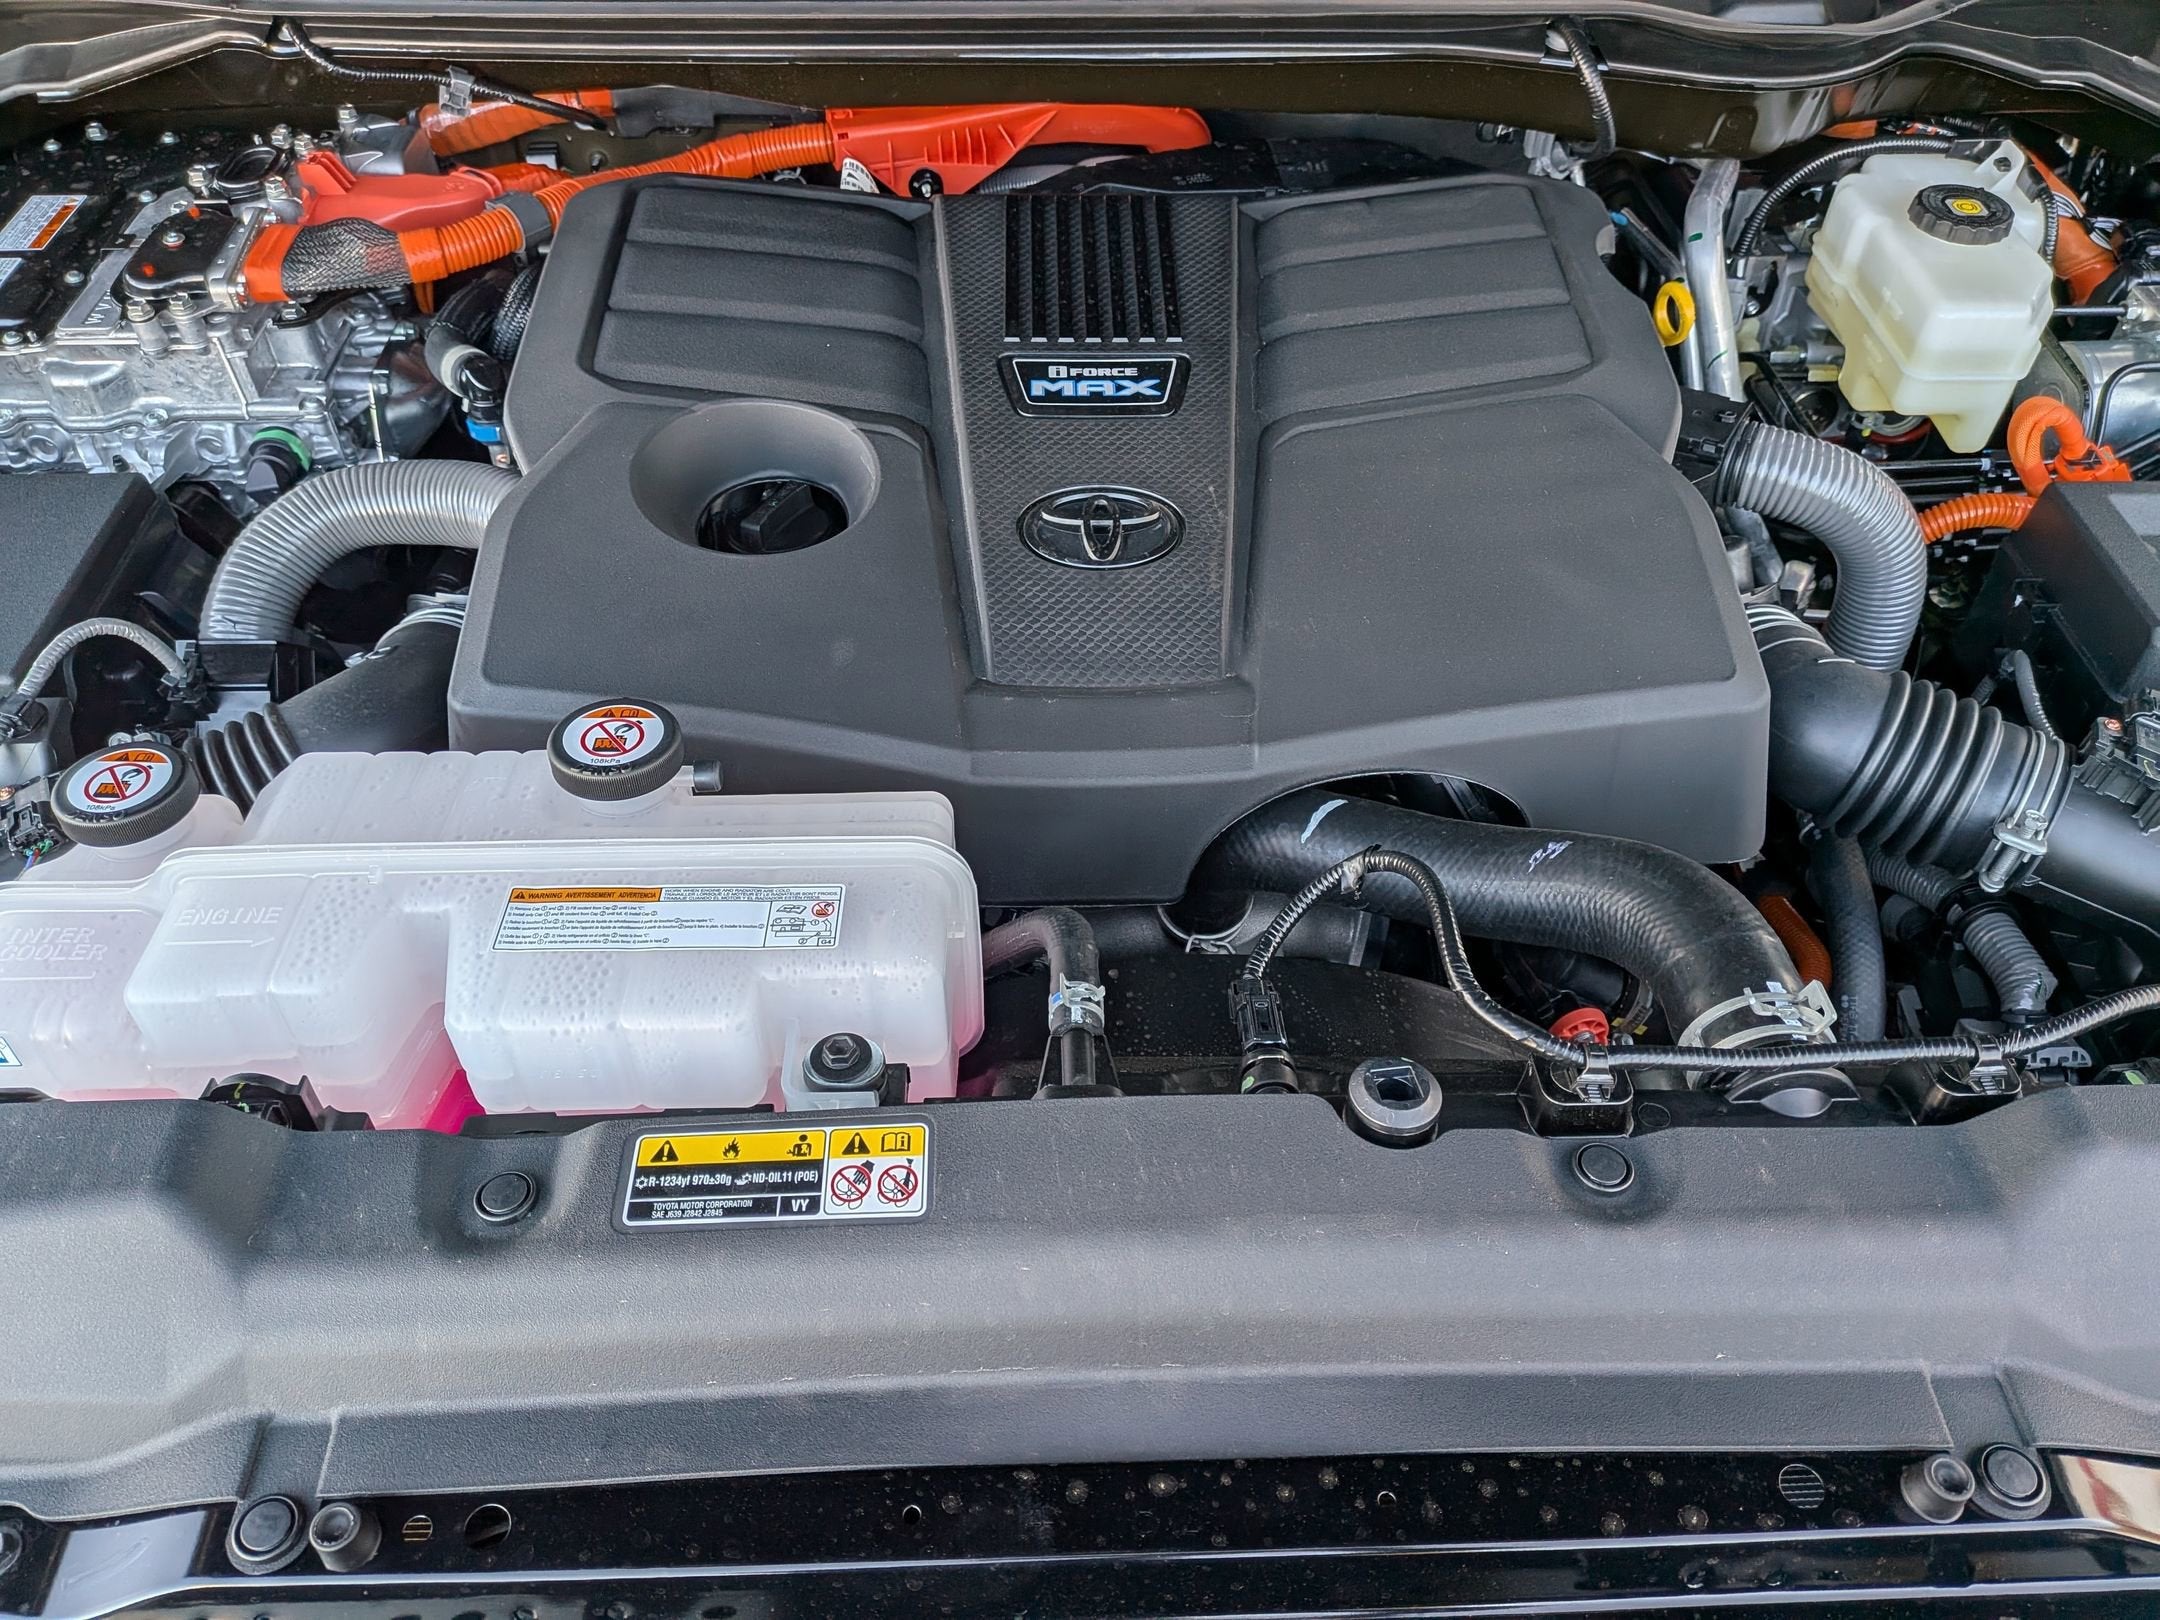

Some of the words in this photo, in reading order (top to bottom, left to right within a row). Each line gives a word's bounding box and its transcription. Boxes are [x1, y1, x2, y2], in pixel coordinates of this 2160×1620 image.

[1069, 366, 1138, 377] FORCE
[1030, 379, 1162, 397] MAX
[565, 891, 616, 899] AVERTISSEMENT
[618, 891, 657, 899] ADVERTENCIA
[174, 907, 284, 926] ENGINE
[5, 927, 96, 945] INTER
[0, 943, 108, 962] COOLER
[648, 1175, 690, 1188] R-1234yf
[692, 1173, 732, 1187] 970±30g
[752, 1171, 793, 1184] ND-OIL11
[794, 1170, 818, 1184] (POE)
[653, 1202, 679, 1211] TOYOTA
[679, 1201, 705, 1210] MOTOR
[705, 1199, 753, 1209] CORPORATION
[791, 1198, 810, 1212] VY
[651, 1211, 665, 1219] SAE
[665, 1210, 682, 1218] J639
[682, 1209, 702, 1218] J2842
[703, 1208, 723, 1217] J2845
